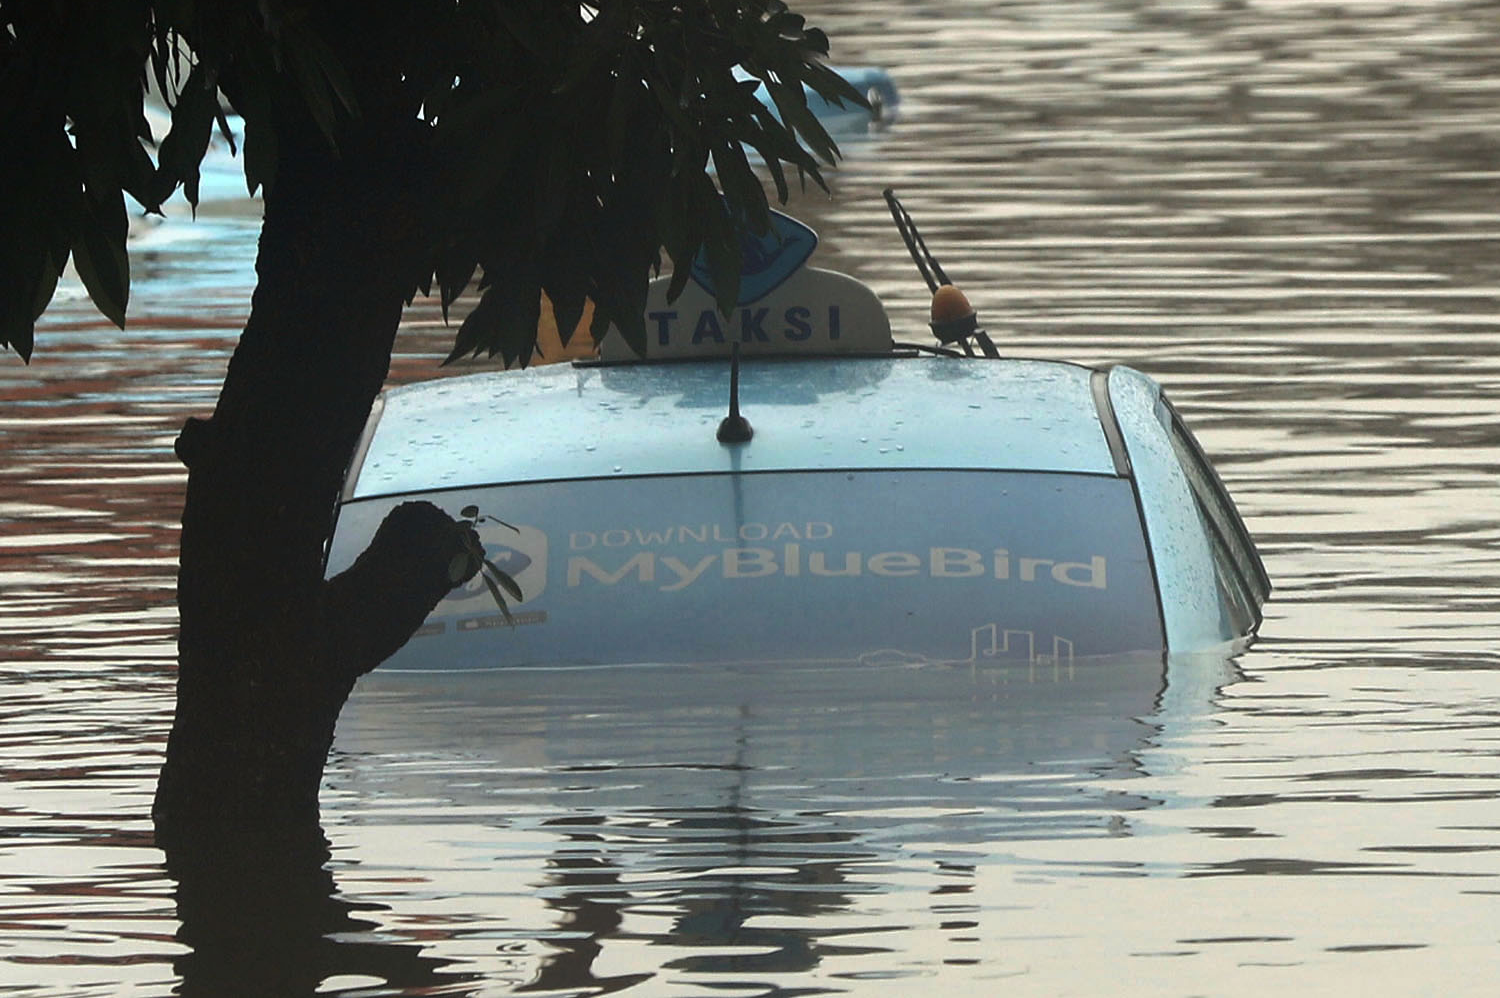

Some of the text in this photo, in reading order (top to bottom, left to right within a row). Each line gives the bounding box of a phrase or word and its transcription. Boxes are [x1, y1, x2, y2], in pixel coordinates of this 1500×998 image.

[649, 305, 841, 346] TAKSI
[569, 521, 833, 549] DOWNLOAD
[567, 543, 1107, 591] MyBlueBird
